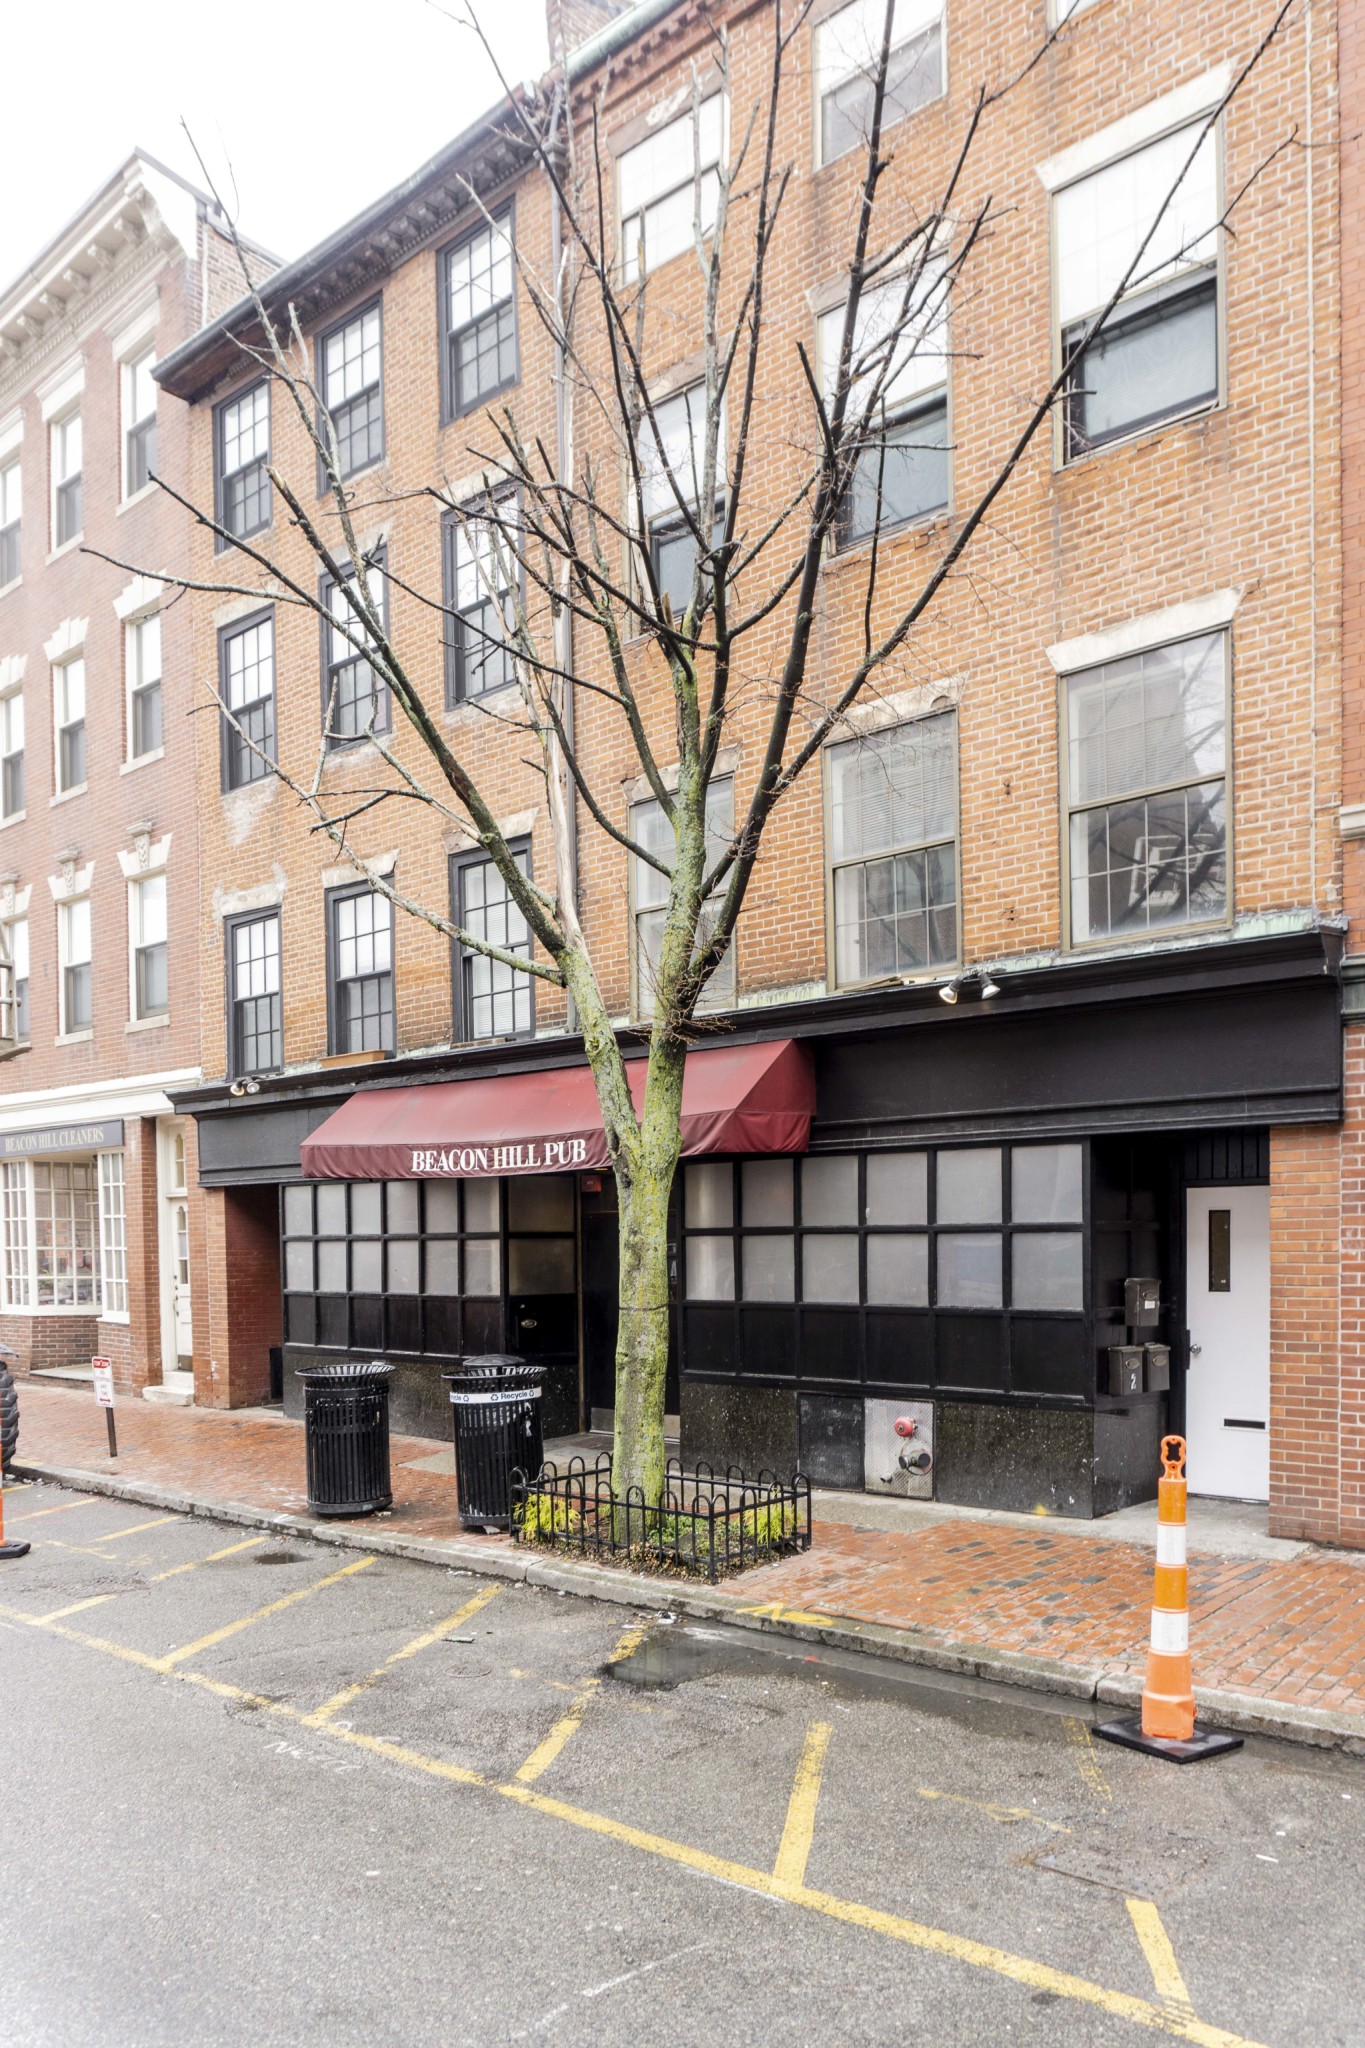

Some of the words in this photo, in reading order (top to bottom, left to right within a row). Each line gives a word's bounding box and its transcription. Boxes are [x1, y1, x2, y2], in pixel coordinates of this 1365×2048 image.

[5, 1136, 37, 1151] BEACON
[38, 1132, 59, 1148] HILL
[59, 1128, 104, 1144] CLEANERS
[411, 1147, 489, 1172] BEACON
[492, 1143, 541, 1169] HILL
[544, 1139, 586, 1165] PUB
[1130, 1372, 1137, 1390] 2
[500, 1392, 528, 1400] Recycle
